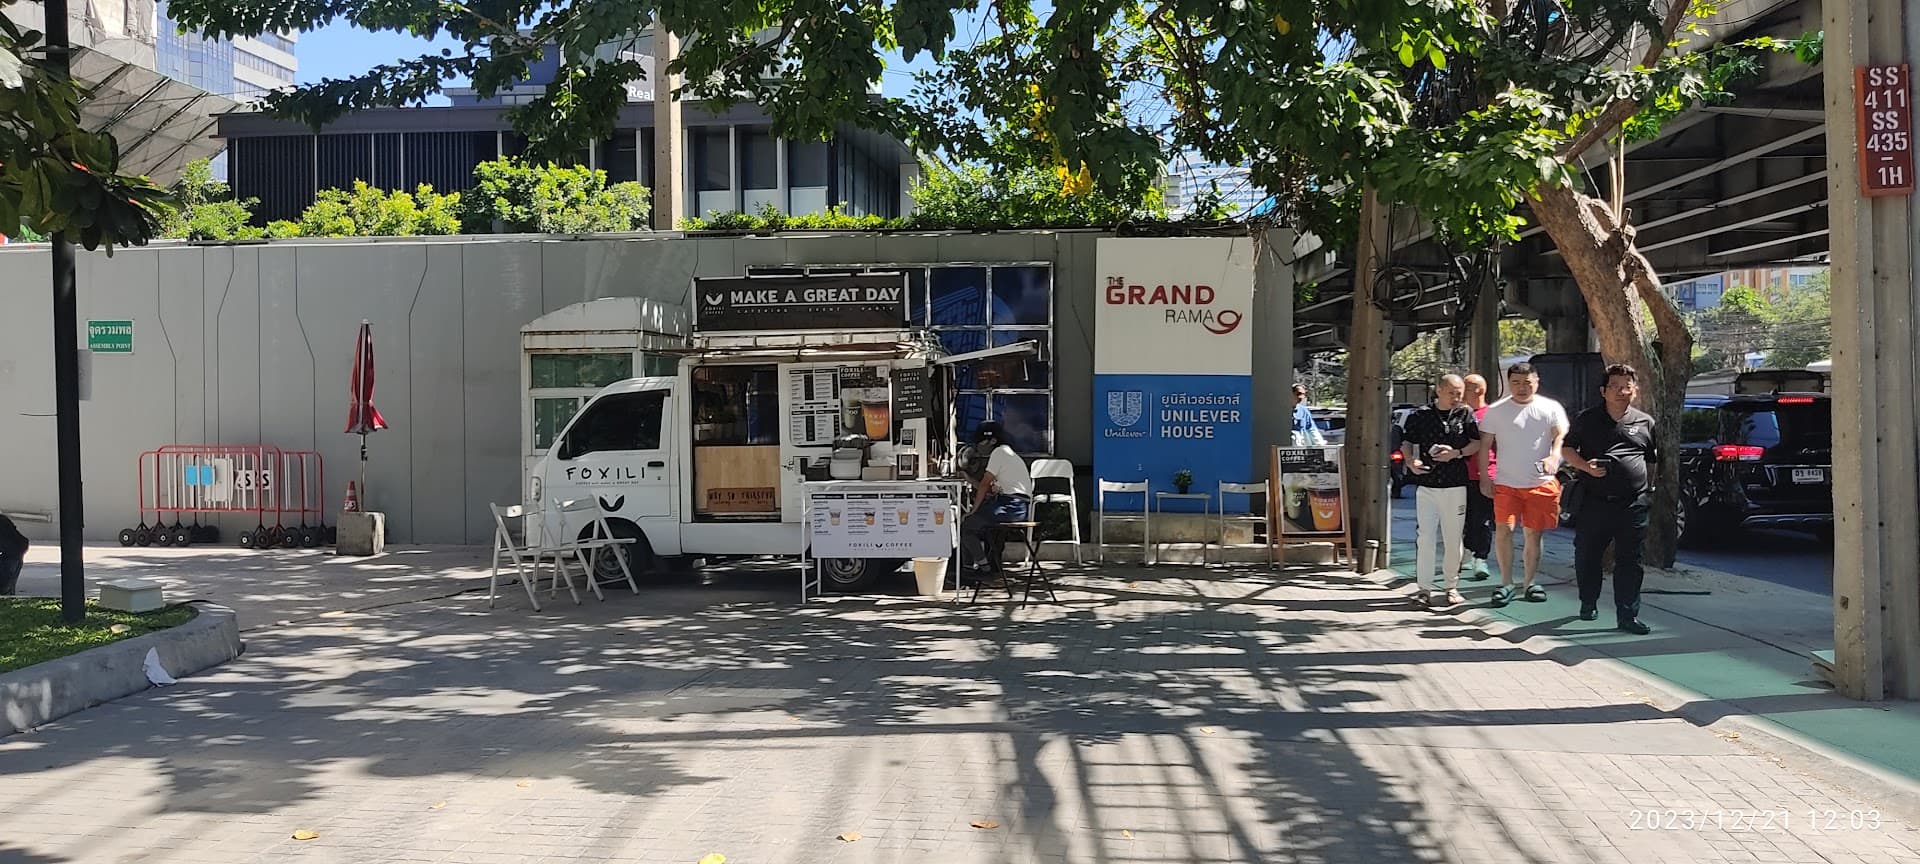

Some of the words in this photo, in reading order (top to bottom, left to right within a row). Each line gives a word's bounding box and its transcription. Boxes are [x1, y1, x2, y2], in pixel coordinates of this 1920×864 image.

[1864, 88, 1905, 109] 411
[1871, 110, 1899, 131] SS
[1866, 131, 1908, 152] 435
[1877, 165, 1903, 186] 1H
[1105, 276, 1125, 289] THE
[730, 290, 778, 304] MAKE
[784, 289, 797, 303] A
[803, 288, 859, 302] GREAT
[865, 287, 900, 301] DAY
[1105, 284, 1215, 305] GRAND
[1164, 309, 1215, 324] RAMA
[1161, 392, 1241, 408] ยูนิลีเวอร์เฮาส์
[1161, 409, 1241, 423] UNILEVER
[1104, 428, 1147, 438] Unilever
[1161, 425, 1215, 439] HOUSE
[565, 466, 645, 480] FOXILI
